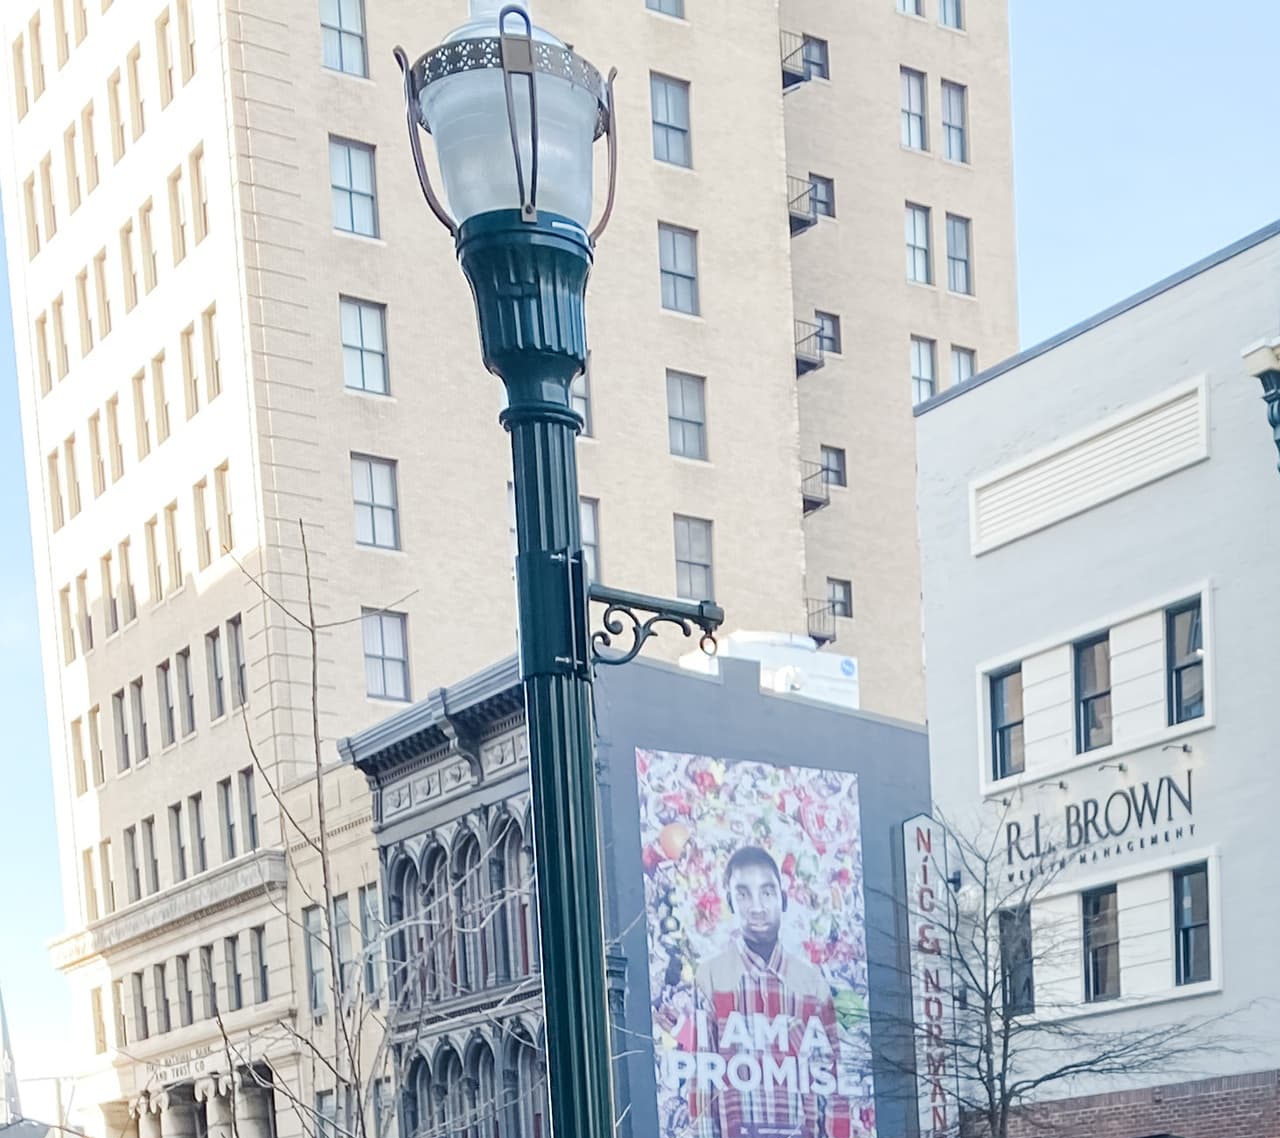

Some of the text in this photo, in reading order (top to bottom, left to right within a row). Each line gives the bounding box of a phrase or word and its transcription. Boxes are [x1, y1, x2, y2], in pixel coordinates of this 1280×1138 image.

[1065, 769, 1193, 850] BROWN
[1079, 823, 1196, 865] MANAGEMENT
[917, 924, 942, 956] &
[696, 1008, 834, 1056] I AM A
[668, 1048, 866, 1097] PROMISE
